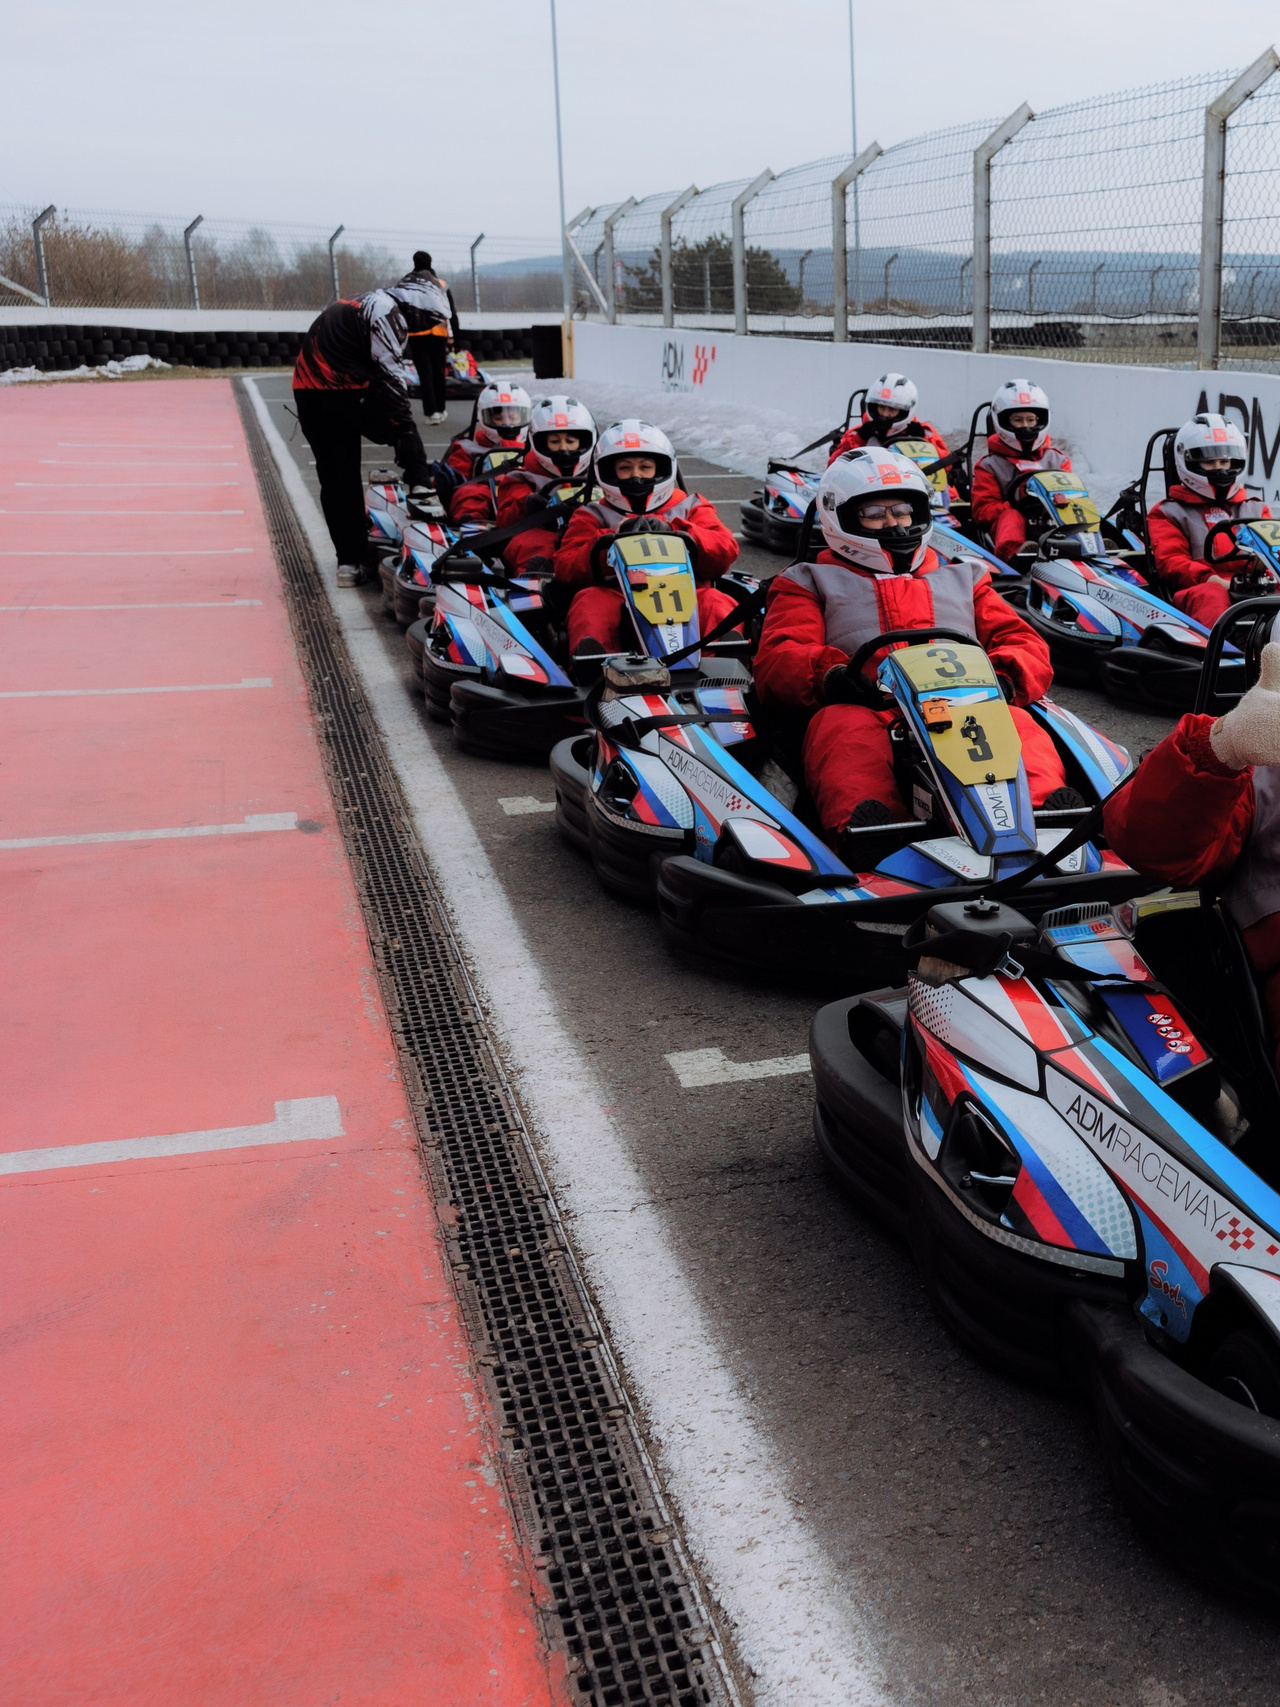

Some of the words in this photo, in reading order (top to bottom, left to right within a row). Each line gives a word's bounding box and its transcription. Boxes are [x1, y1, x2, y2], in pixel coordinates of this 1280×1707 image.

[662, 341, 684, 380] ADM
[905, 443, 932, 453] 12
[1052, 473, 1072, 486] 8
[1072, 508, 1088, 524] 8
[633, 538, 669, 556] 11
[649, 590, 683, 613] 11
[1096, 589, 1151, 617] ADMRACEWAY
[926, 648, 967, 678] 3
[960, 724, 993, 762] 3
[667, 749, 733, 806] ADMRACEWAY
[1065, 1094, 1231, 1233] ADMRACEWAY
[1149, 1259, 1188, 1319] Sodi
